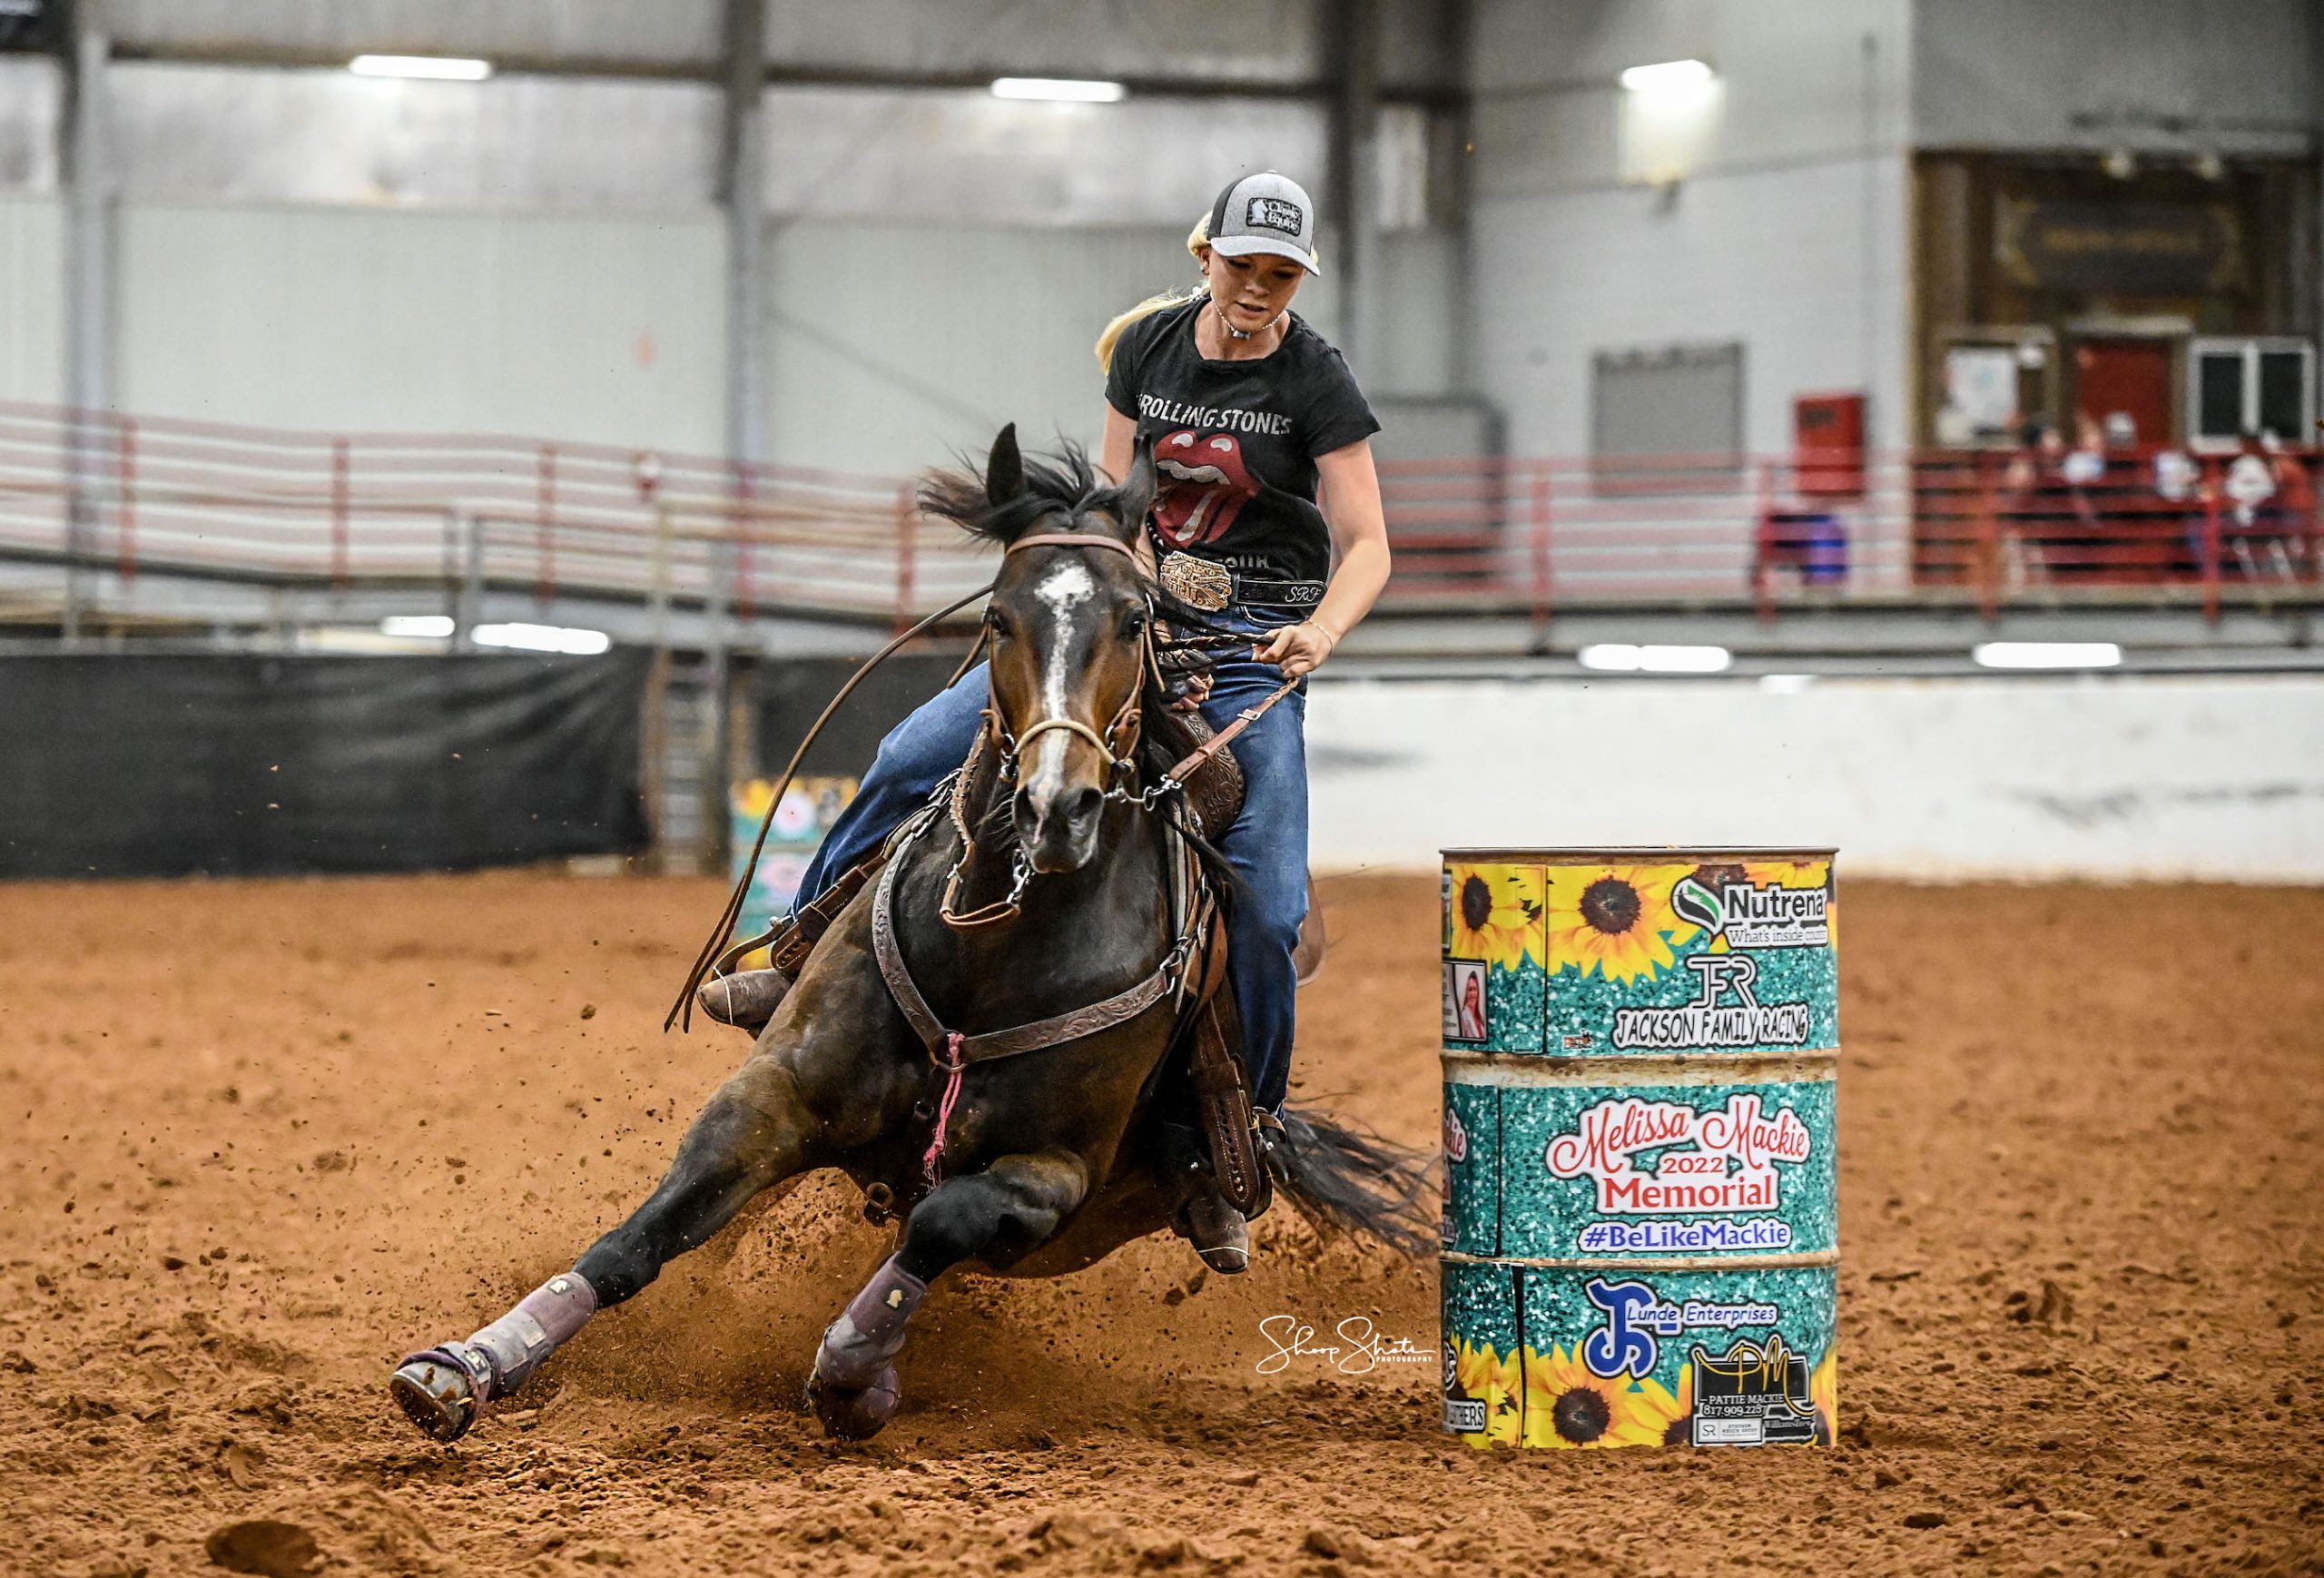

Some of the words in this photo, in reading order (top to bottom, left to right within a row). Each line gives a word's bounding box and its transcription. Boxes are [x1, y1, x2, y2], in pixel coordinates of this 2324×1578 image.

[1138, 393, 1219, 428] ROLLING
[1216, 409, 1293, 436] STONES
[1728, 889, 1824, 918] Nutrena
[1728, 928, 1770, 943] What's
[1772, 926, 1804, 942] inside
[1617, 1011, 1696, 1044] JACKSON
[1701, 1011, 1758, 1042] FAMILY
[1761, 1009, 1807, 1040] RACING
[1553, 1103, 1690, 1174] Melissa
[1701, 1100, 1806, 1170] Mackie
[1662, 1157, 1725, 1175] 2022
[1602, 1175, 1771, 1208] Memorial
[1584, 1222, 1787, 1248] #BeLikeMackie
[1626, 1306, 1678, 1322] Lunde
[1686, 1305, 1775, 1326] Enterprises
[1709, 1395, 1746, 1405] PATTIE
[1748, 1394, 1785, 1404] MACKIE
